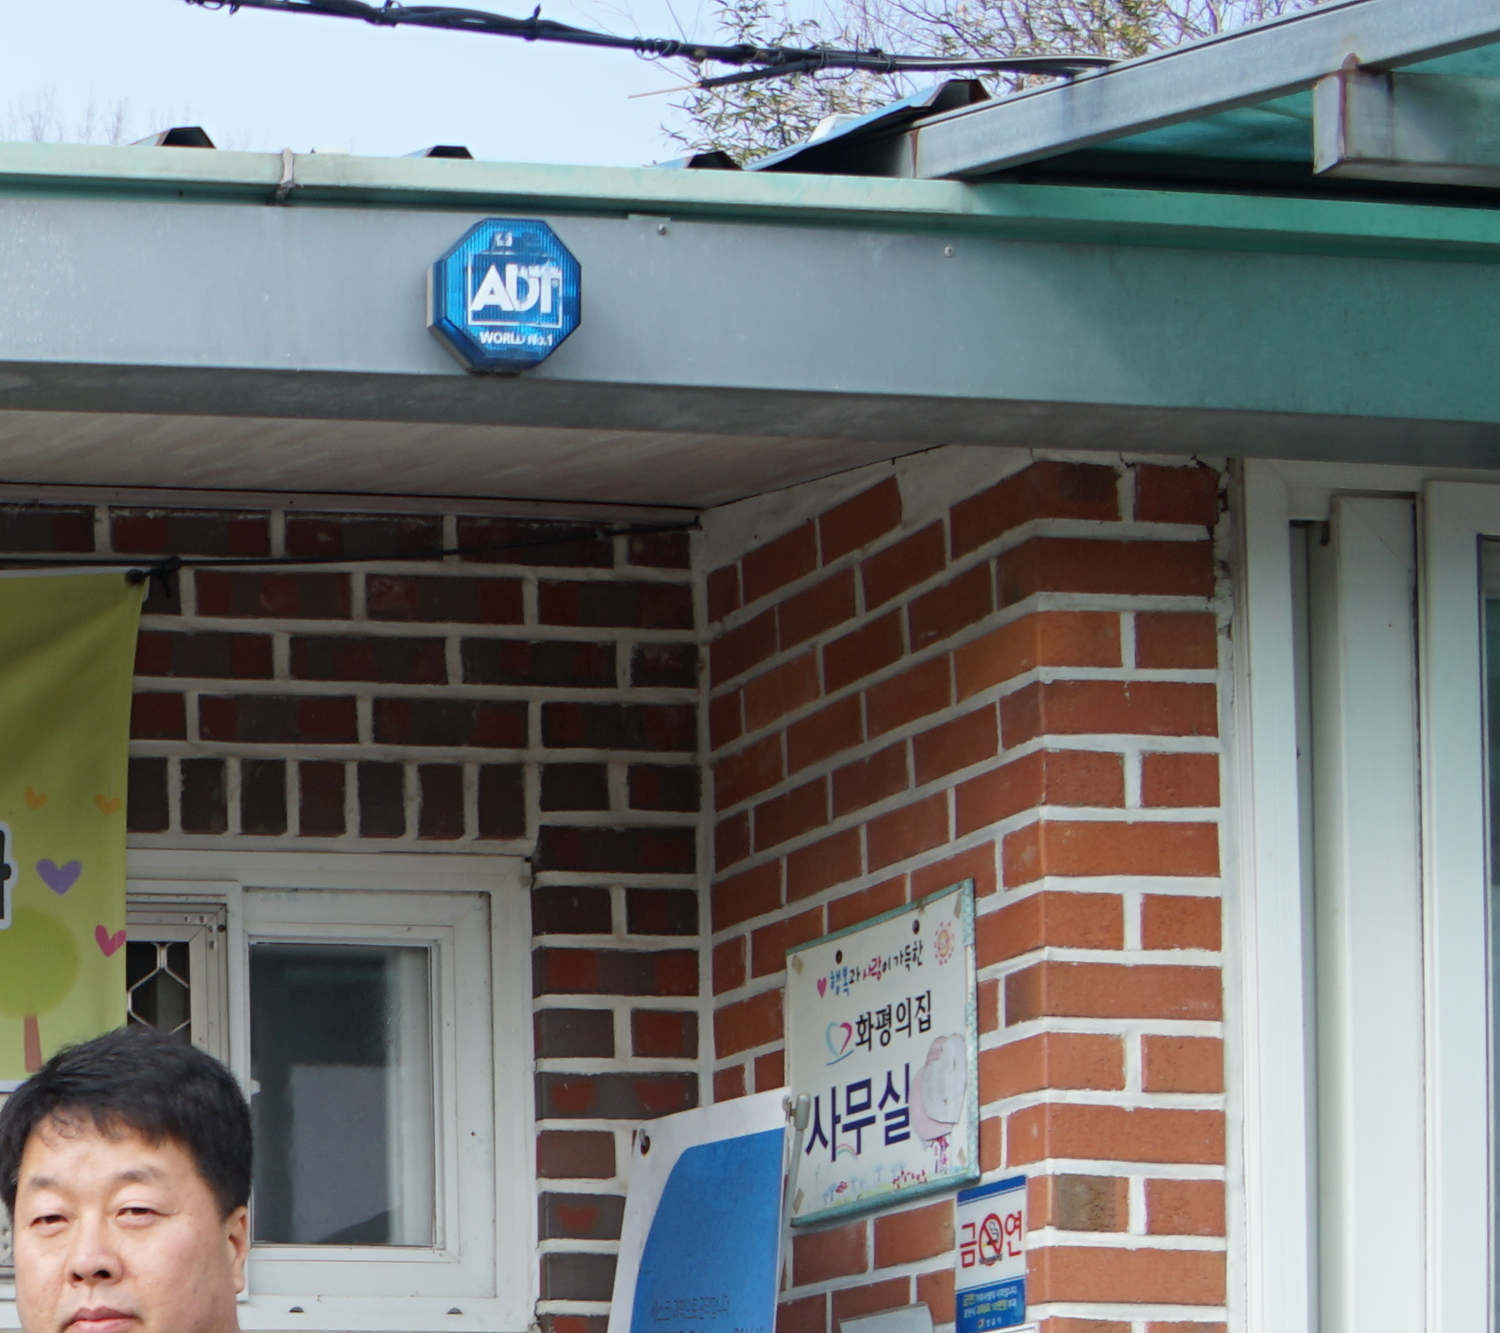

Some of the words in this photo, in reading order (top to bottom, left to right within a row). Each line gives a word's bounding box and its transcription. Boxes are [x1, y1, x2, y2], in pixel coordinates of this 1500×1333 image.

[469, 263, 561, 314] ADT
[480, 331, 525, 345] WORLD
[893, 941, 924, 972] 가득한
[855, 990, 932, 1052] 화평의집
[804, 1062, 912, 1163] 사무실
